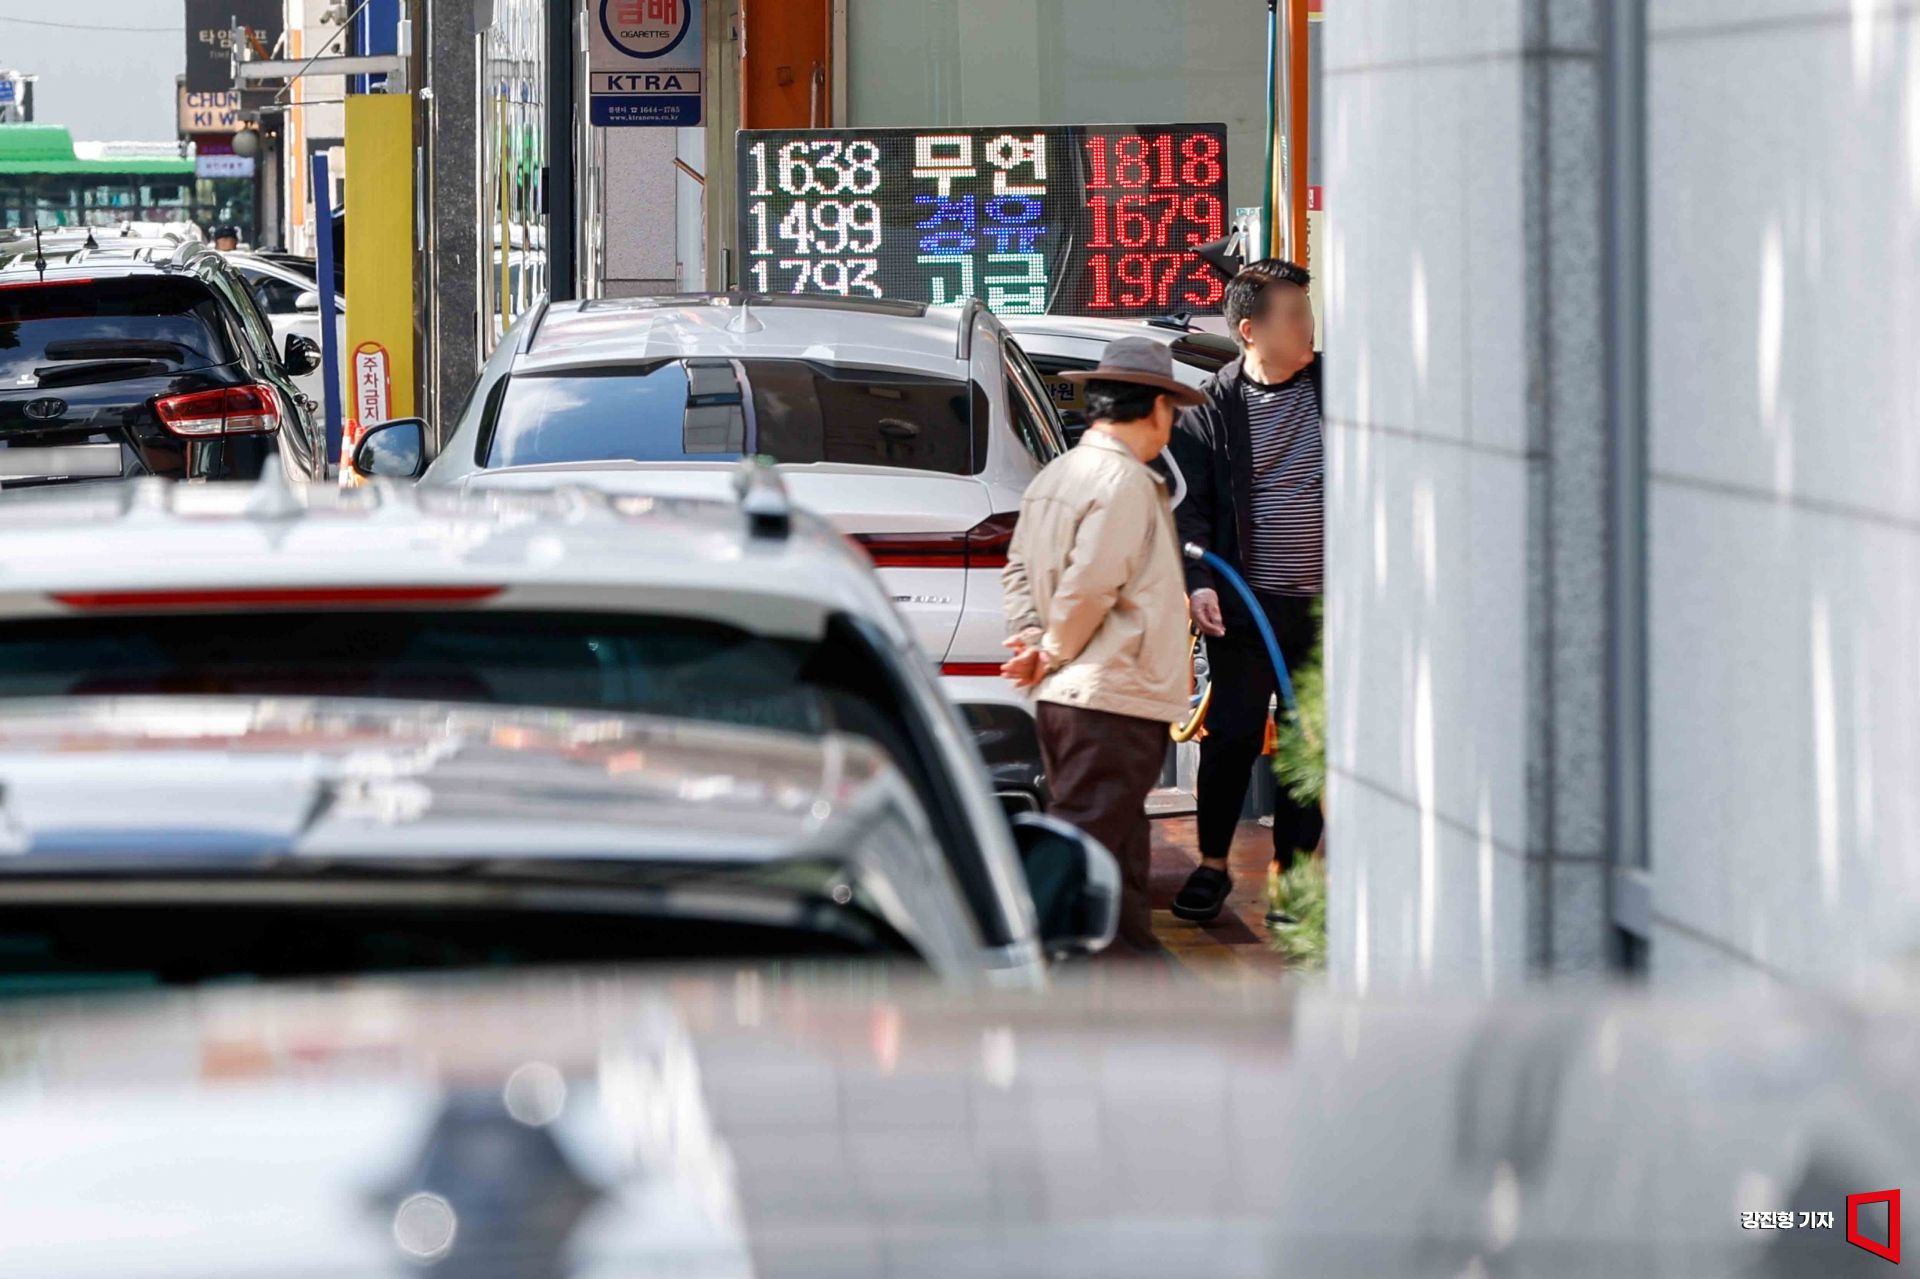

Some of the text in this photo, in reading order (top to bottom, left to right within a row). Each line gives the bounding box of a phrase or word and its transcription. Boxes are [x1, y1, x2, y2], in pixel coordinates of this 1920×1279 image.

[199, 29, 267, 49] 타임프
[615, 0, 677, 25] 담배
[620, 30, 670, 39] CIGARETTES
[186, 92, 239, 108] CHUN
[607, 75, 682, 91] KTRA
[219, 111, 237, 126] W
[749, 141, 880, 195] 1638
[912, 134, 1047, 196] 무연
[1085, 134, 1222, 188] 1818
[749, 200, 882, 254] 1499
[914, 195, 1046, 254] 경유
[1087, 193, 1222, 247] 1679
[750, 259, 883, 298] 1793
[917, 253, 1048, 316] 고급
[1087, 253, 1223, 306] 1973
[362, 356, 380, 421] 주차금지
